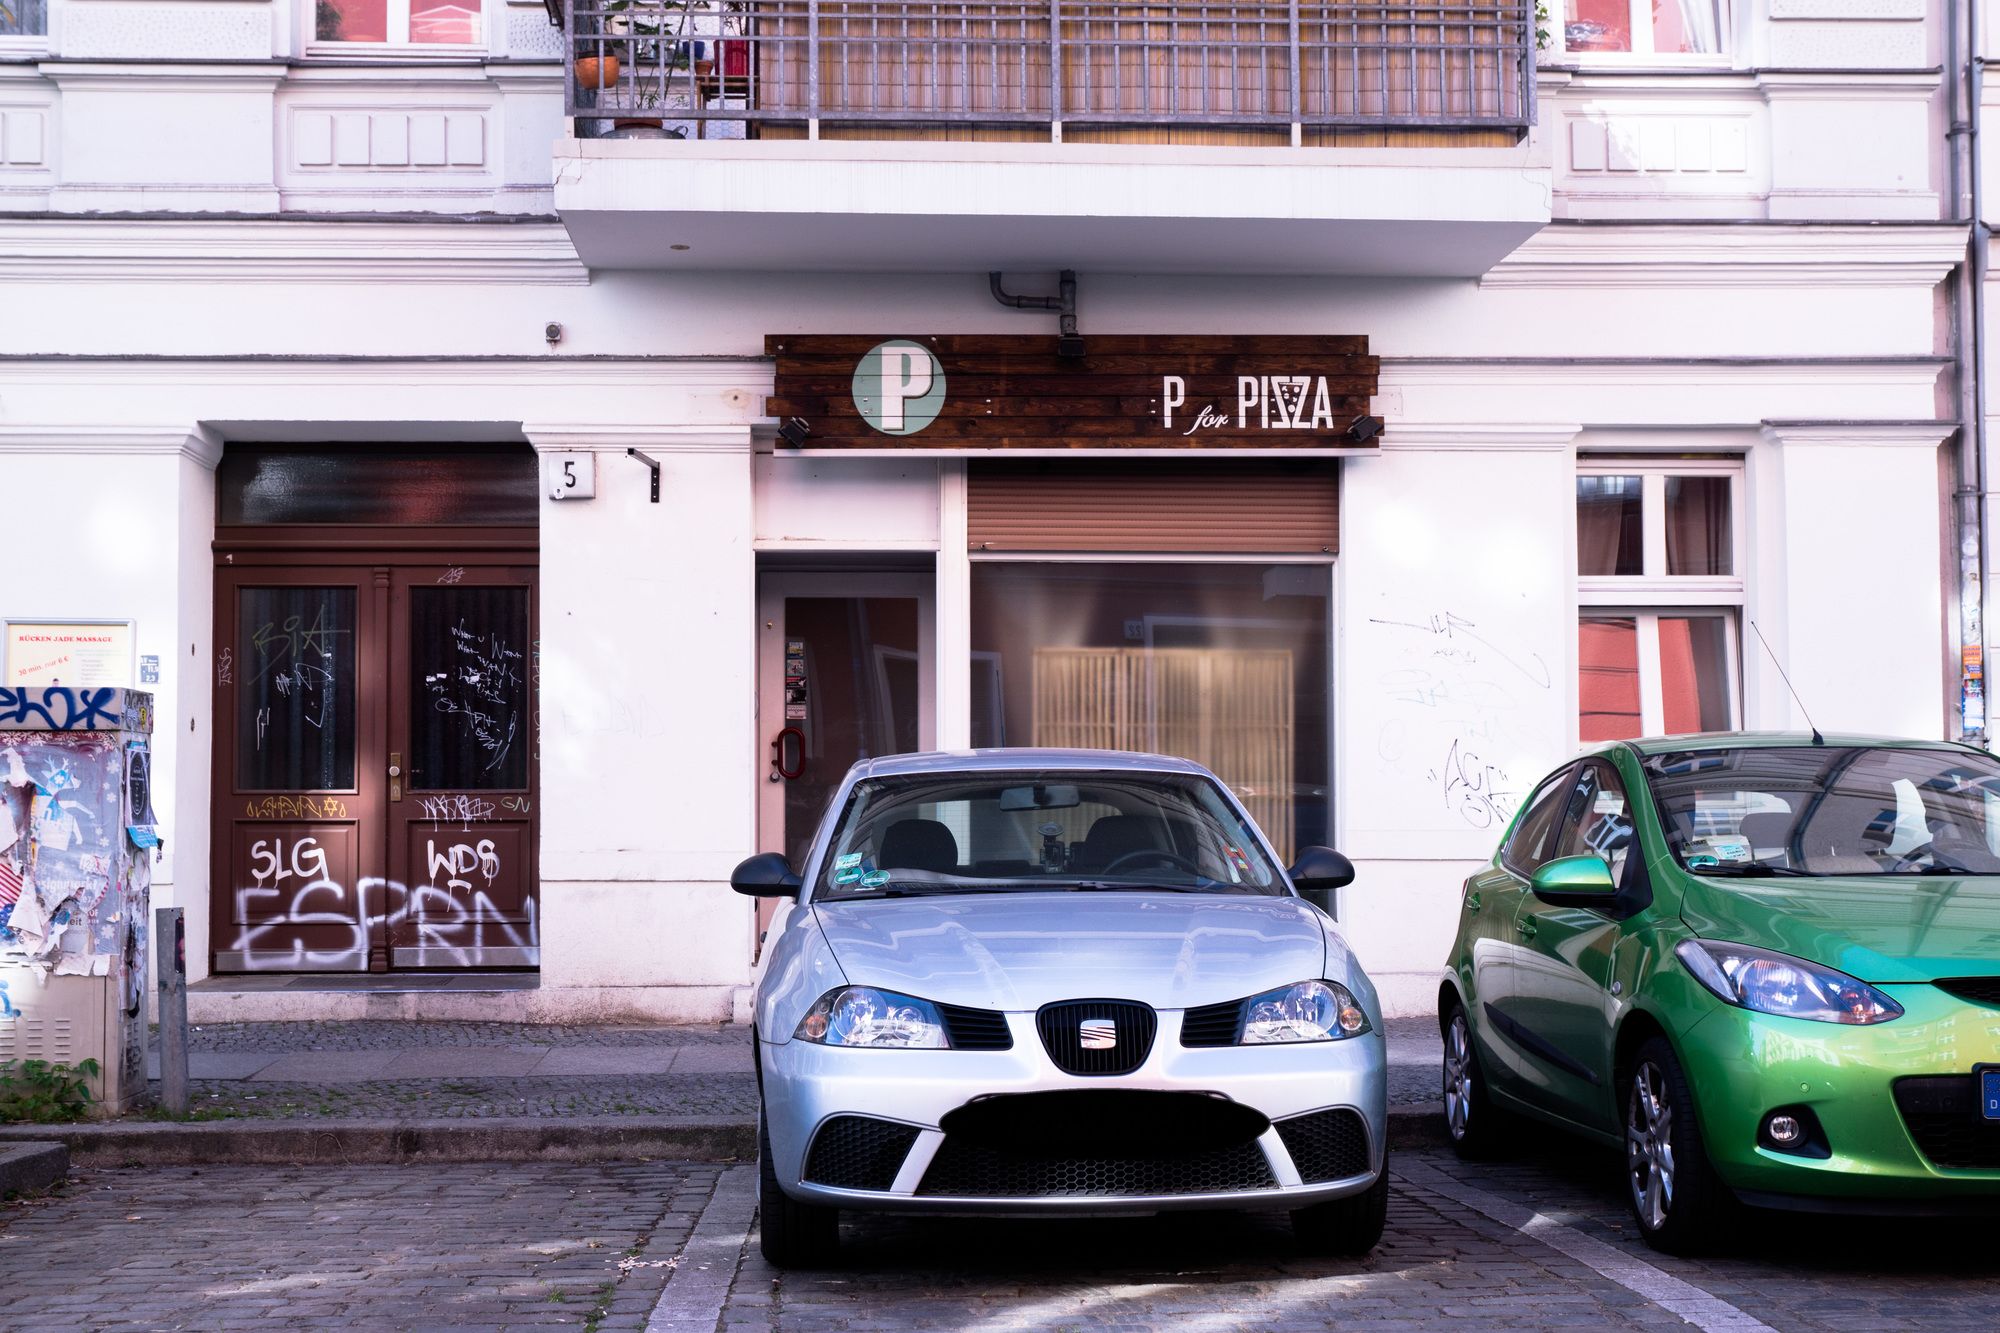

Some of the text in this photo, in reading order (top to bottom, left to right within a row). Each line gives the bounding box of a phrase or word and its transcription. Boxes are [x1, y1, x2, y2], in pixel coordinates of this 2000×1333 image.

[881, 346, 934, 431] P
[1163, 375, 1334, 436] P for PIZZA
[564, 461, 576, 488] 5
[1990, 1099, 1998, 1109] D
